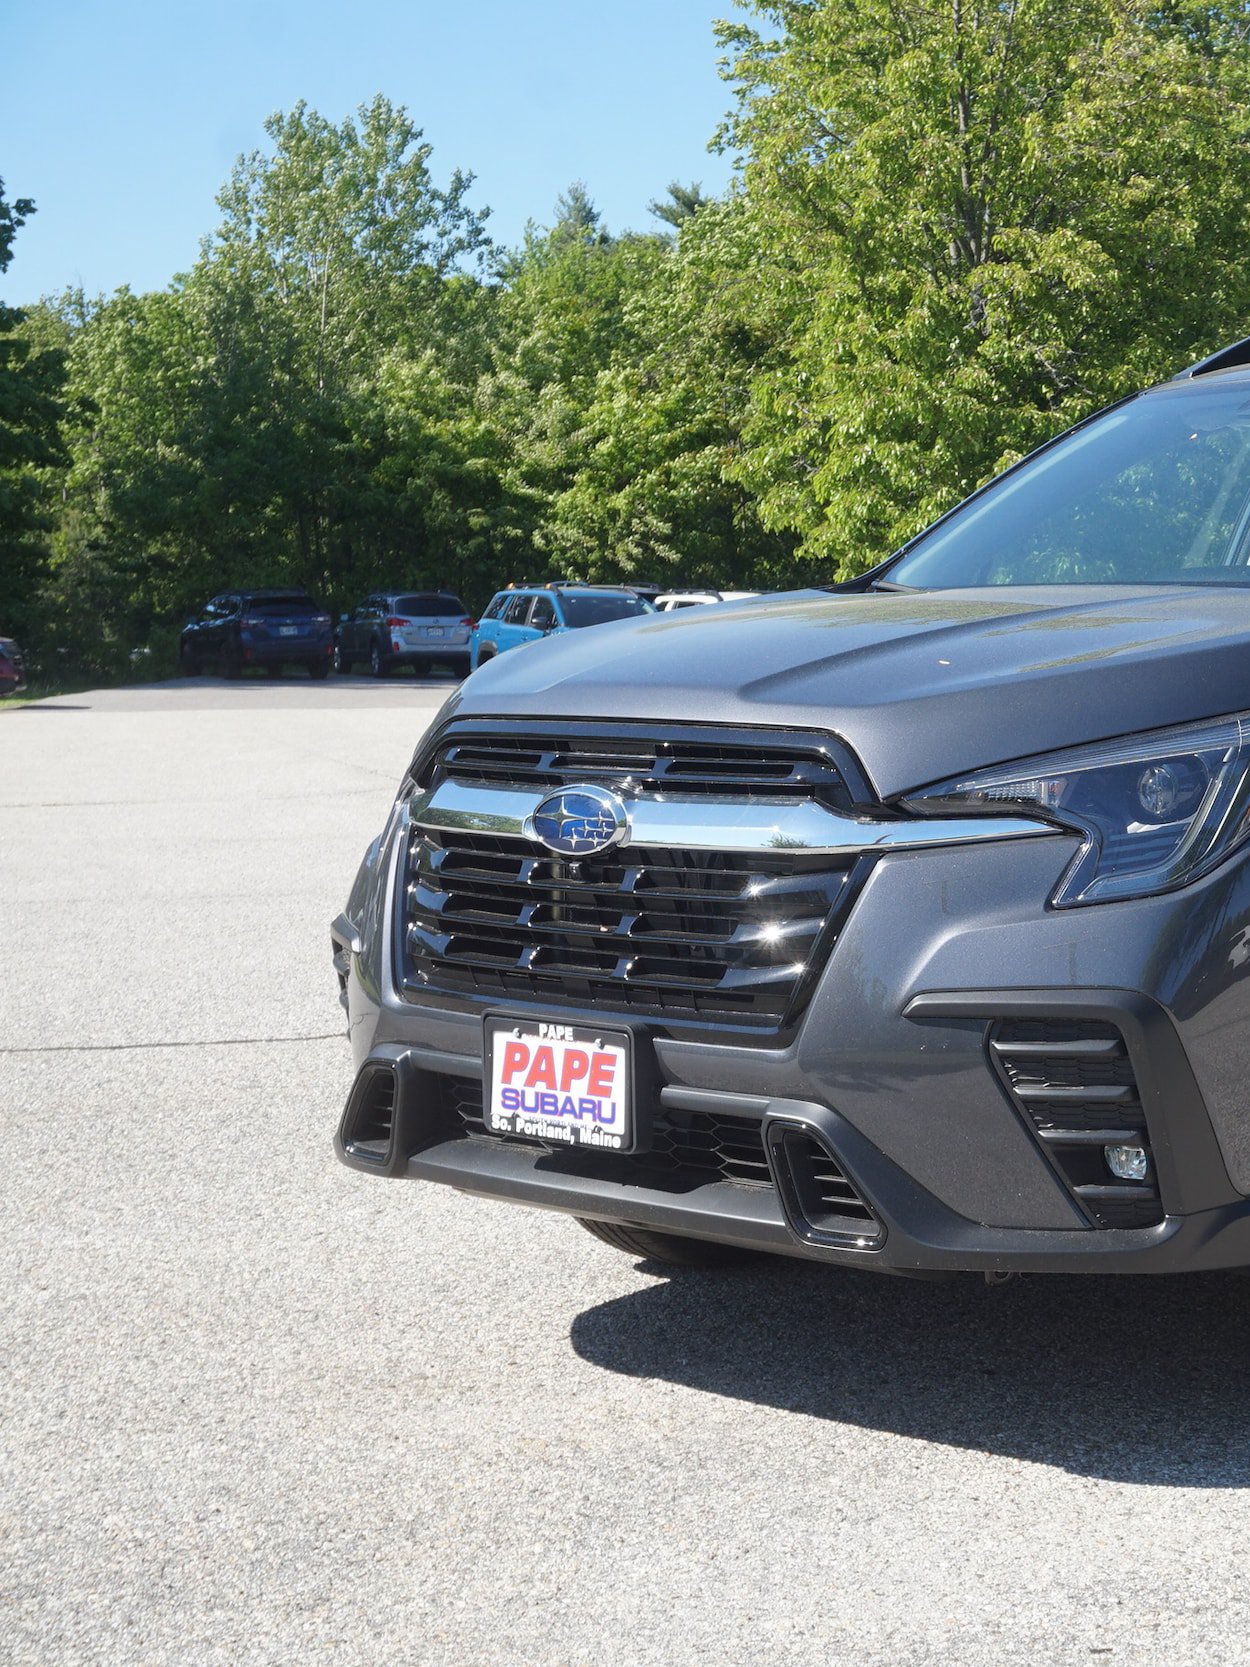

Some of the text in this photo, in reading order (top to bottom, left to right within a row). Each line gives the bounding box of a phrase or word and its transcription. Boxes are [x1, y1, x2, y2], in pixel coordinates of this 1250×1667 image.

[539, 1023, 573, 1041] PAPE
[501, 1041, 617, 1099] PAPE
[501, 1087, 616, 1124] SUBARU
[491, 1114, 621, 1149] So. Portland, Maine
